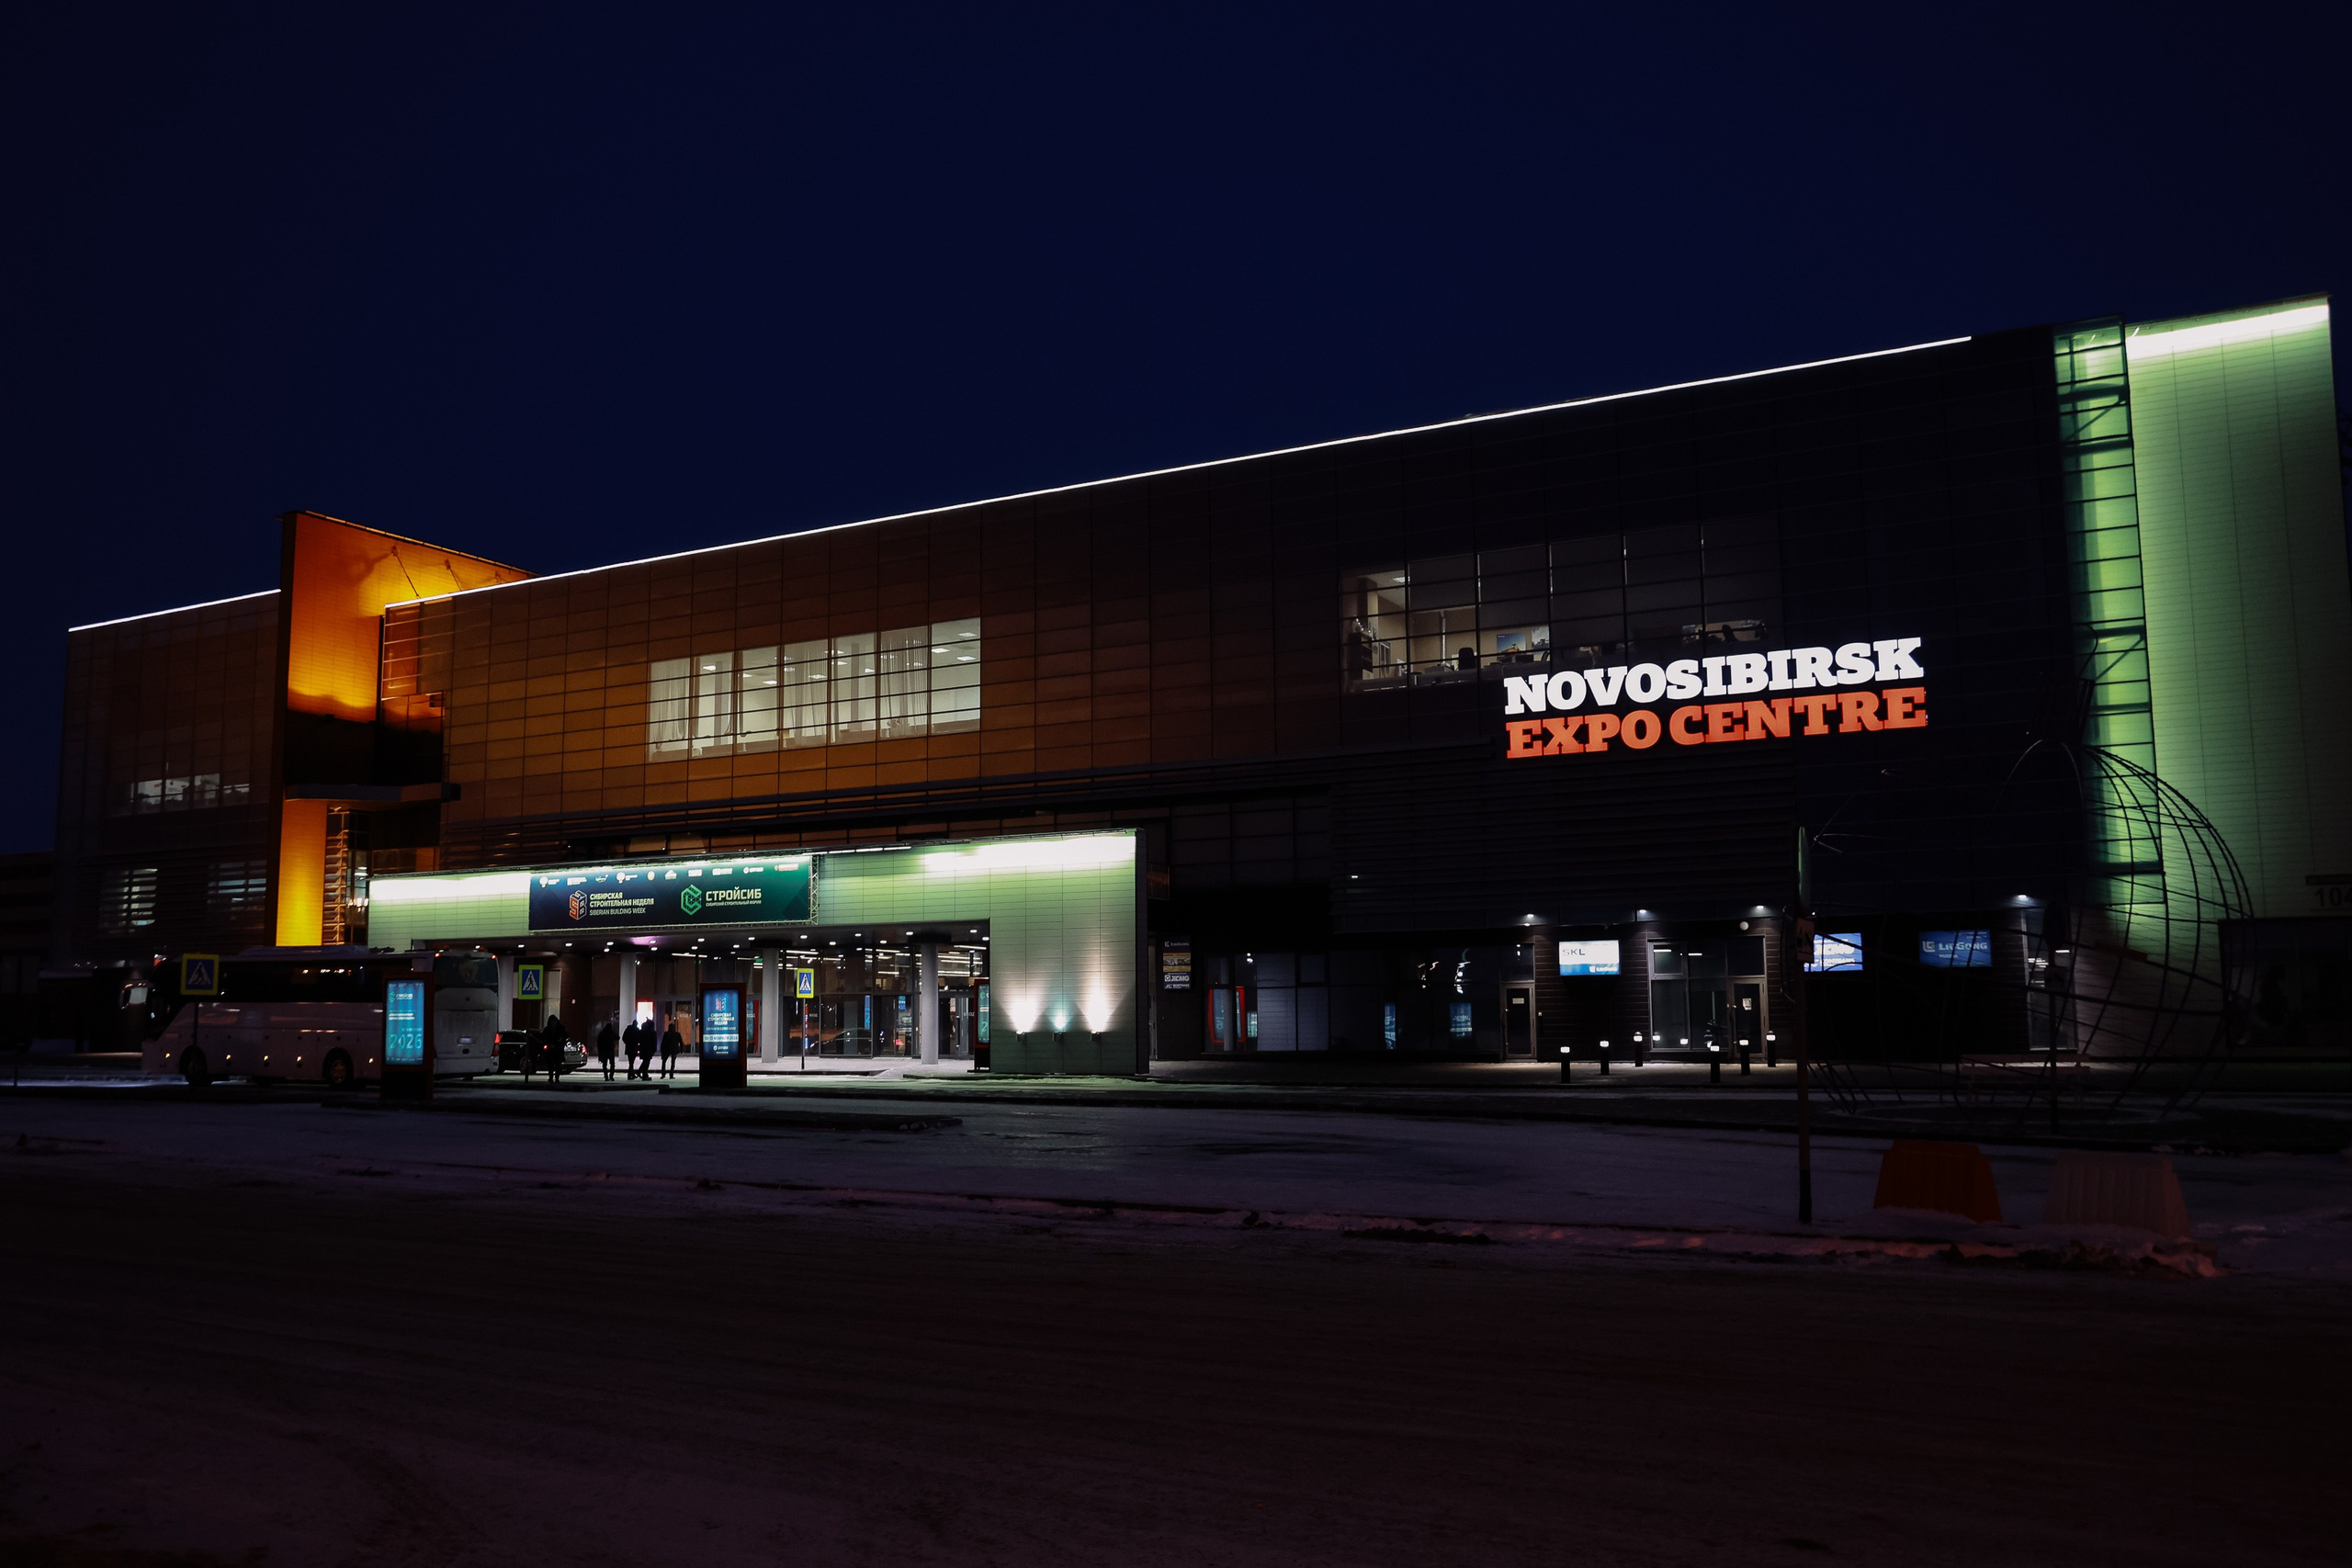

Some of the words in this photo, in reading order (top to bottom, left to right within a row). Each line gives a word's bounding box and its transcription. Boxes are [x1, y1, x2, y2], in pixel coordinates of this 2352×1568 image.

[1504, 637, 1925, 715] NOVOSIBIRSK
[1505, 709, 1662, 759] EXPO
[1668, 686, 1928, 746] CENTRE
[589, 892, 623, 900] СИБИРСКАЯ
[706, 886, 762, 901] СТРОЙСИБ
[589, 899, 632, 908] СТРОИТЕЛЬНАЯ
[633, 898, 654, 907] НЕДЕЛЯ
[1562, 948, 1586, 956] SKL
[390, 1033, 423, 1049] 2026
